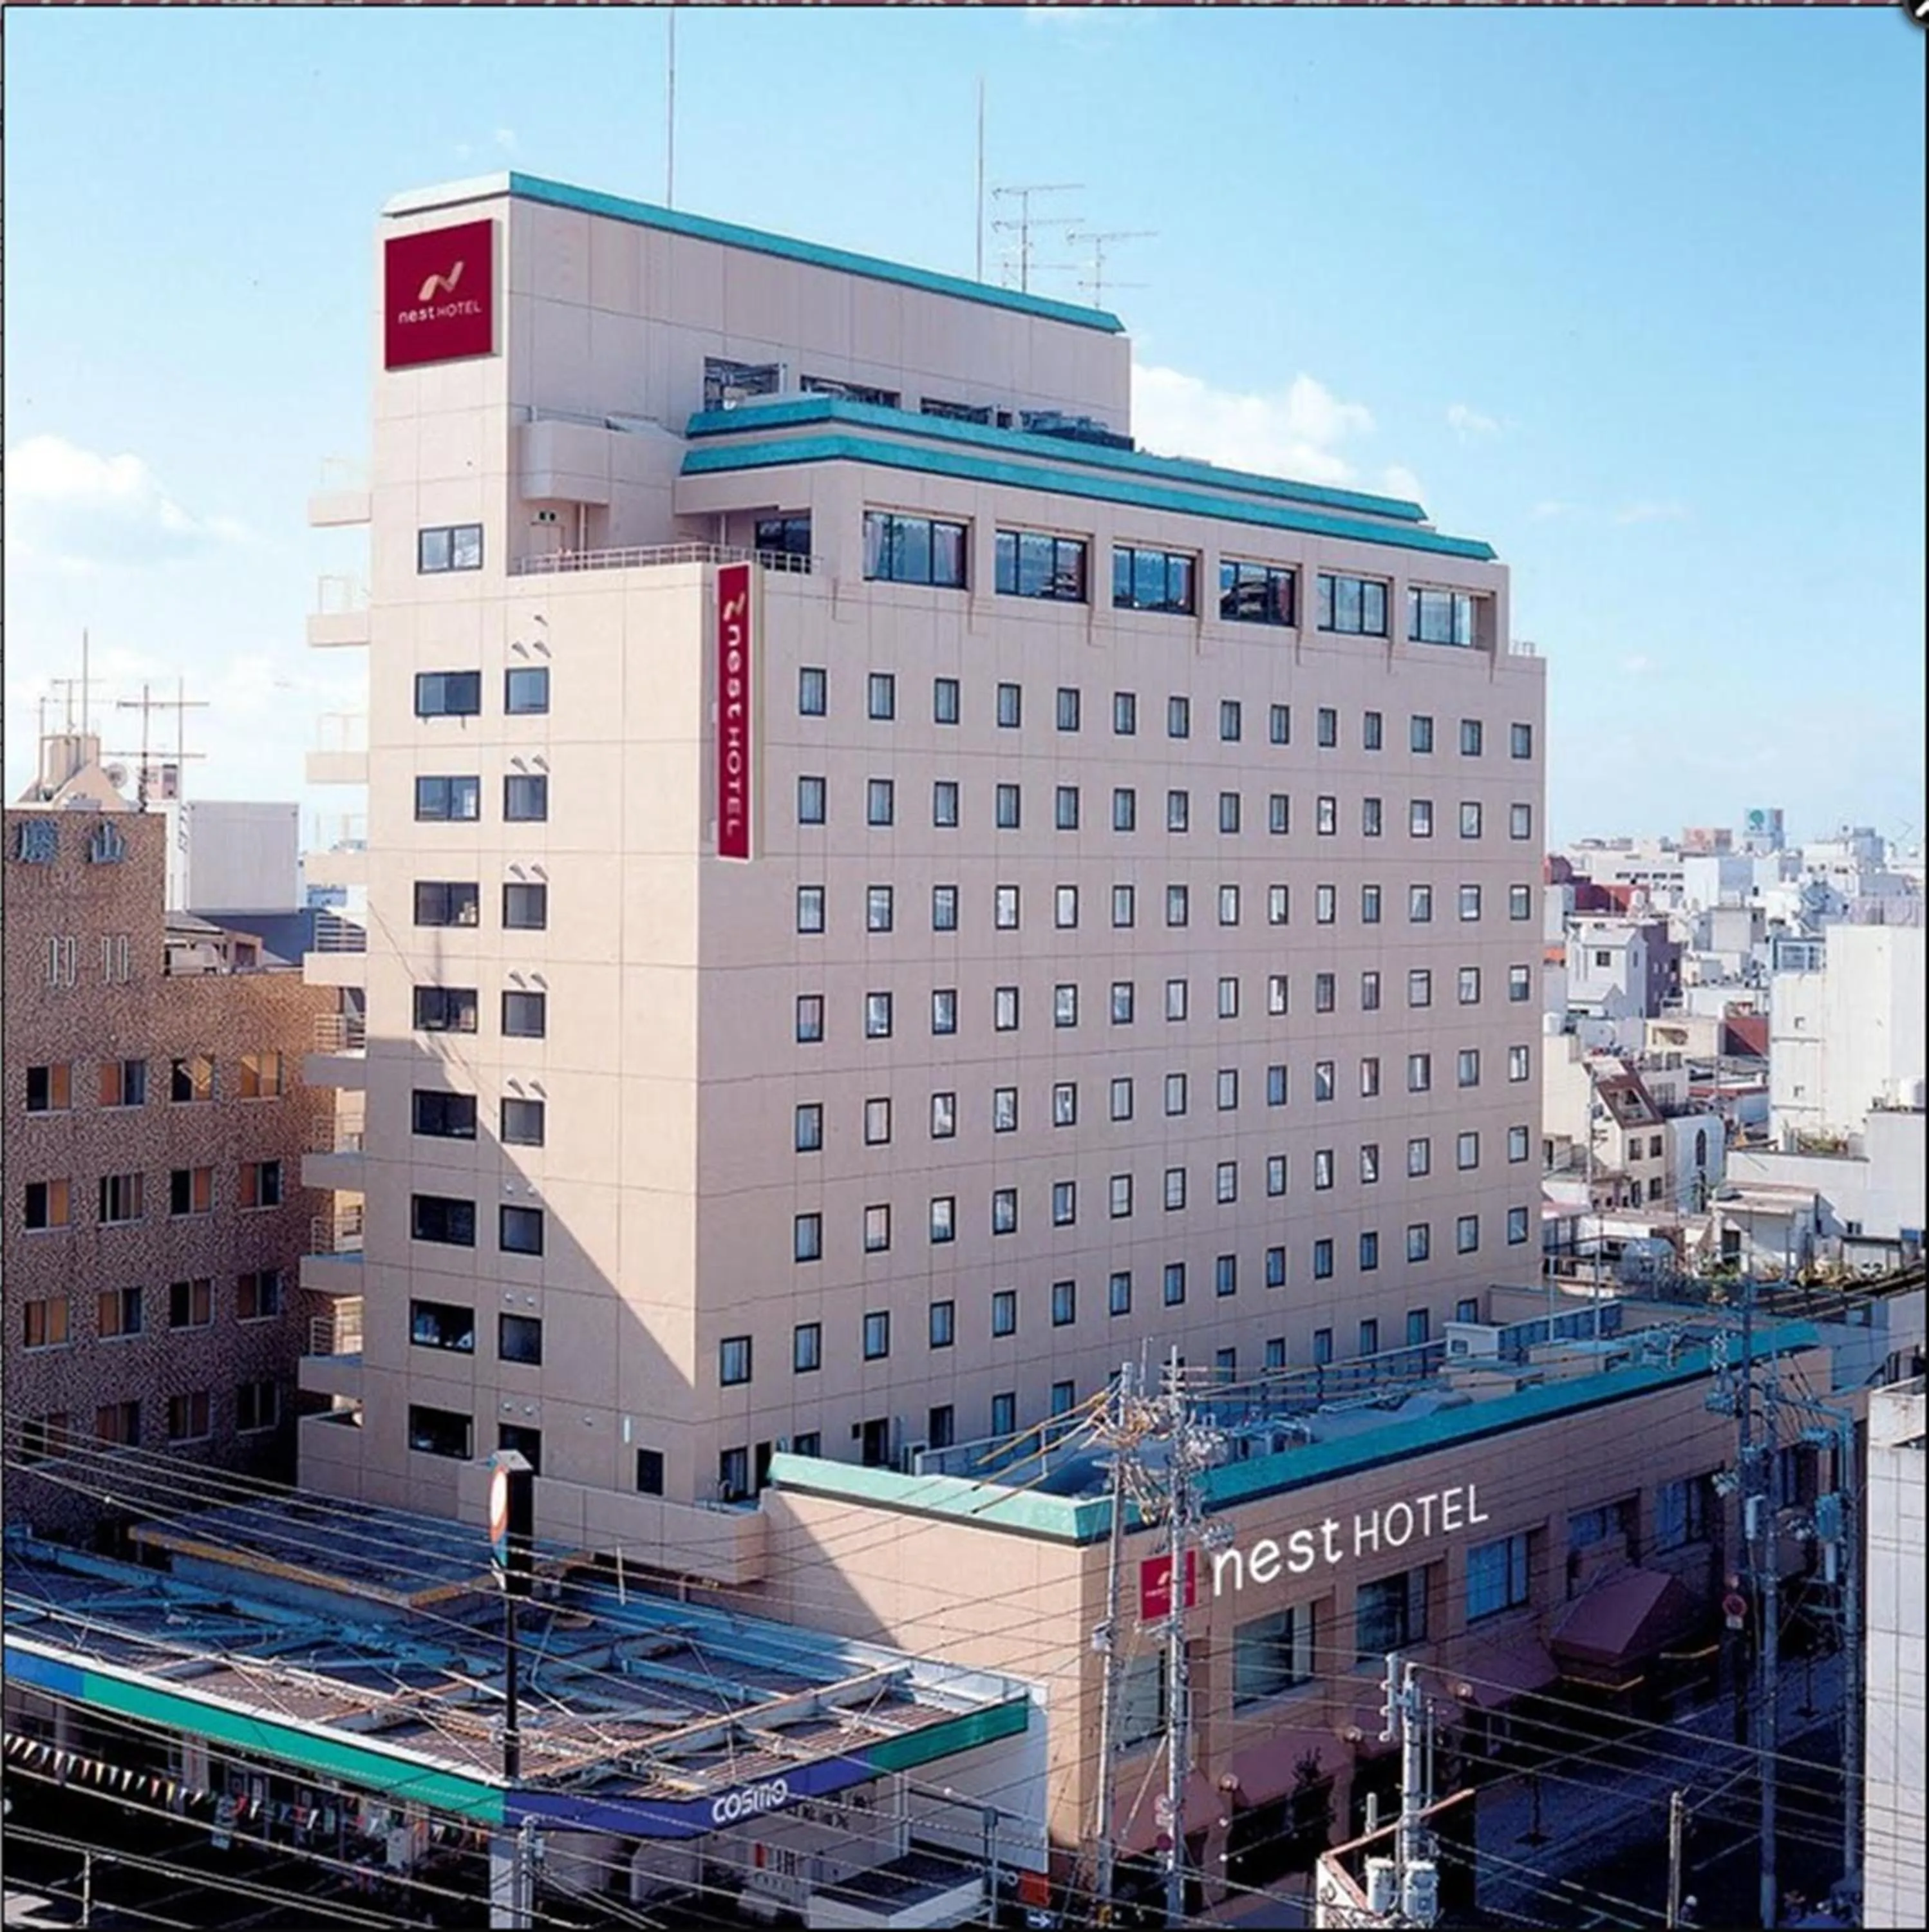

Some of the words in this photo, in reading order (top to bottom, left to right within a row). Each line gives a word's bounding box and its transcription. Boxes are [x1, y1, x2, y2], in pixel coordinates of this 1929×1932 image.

[398, 306, 435, 325] nest
[437, 300, 482, 318] HOTEL
[727, 625, 742, 719] nest
[726, 726, 742, 836] HOTEL
[1213, 1517, 1344, 1596] nest
[1354, 1484, 1489, 1557] HOTEL
